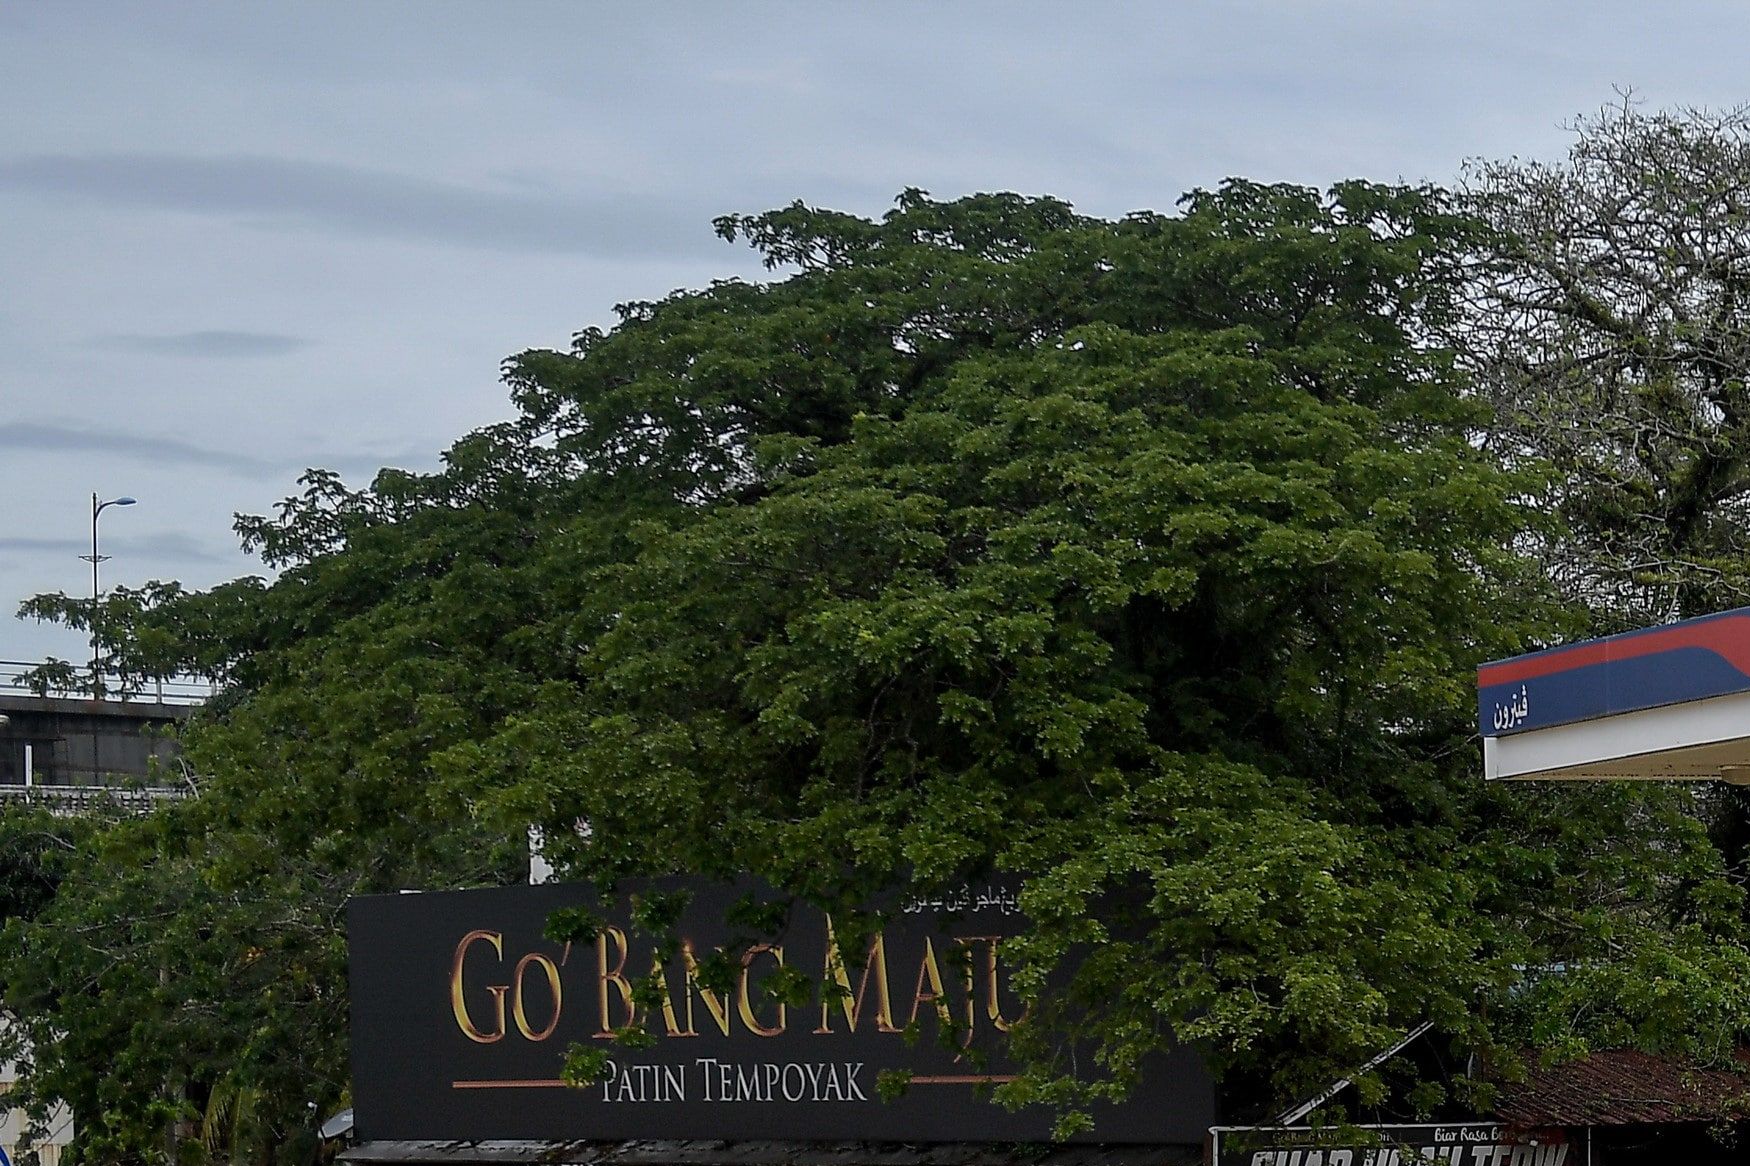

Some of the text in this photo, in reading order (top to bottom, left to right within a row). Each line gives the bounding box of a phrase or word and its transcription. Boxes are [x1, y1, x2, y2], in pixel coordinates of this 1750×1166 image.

[592, 926, 787, 1039] BANG
[602, 1057, 868, 1103] PATIN TEMPOYAK
[1434, 1127, 1457, 1143] Biar
[1460, 1126, 1488, 1143] Rasa
